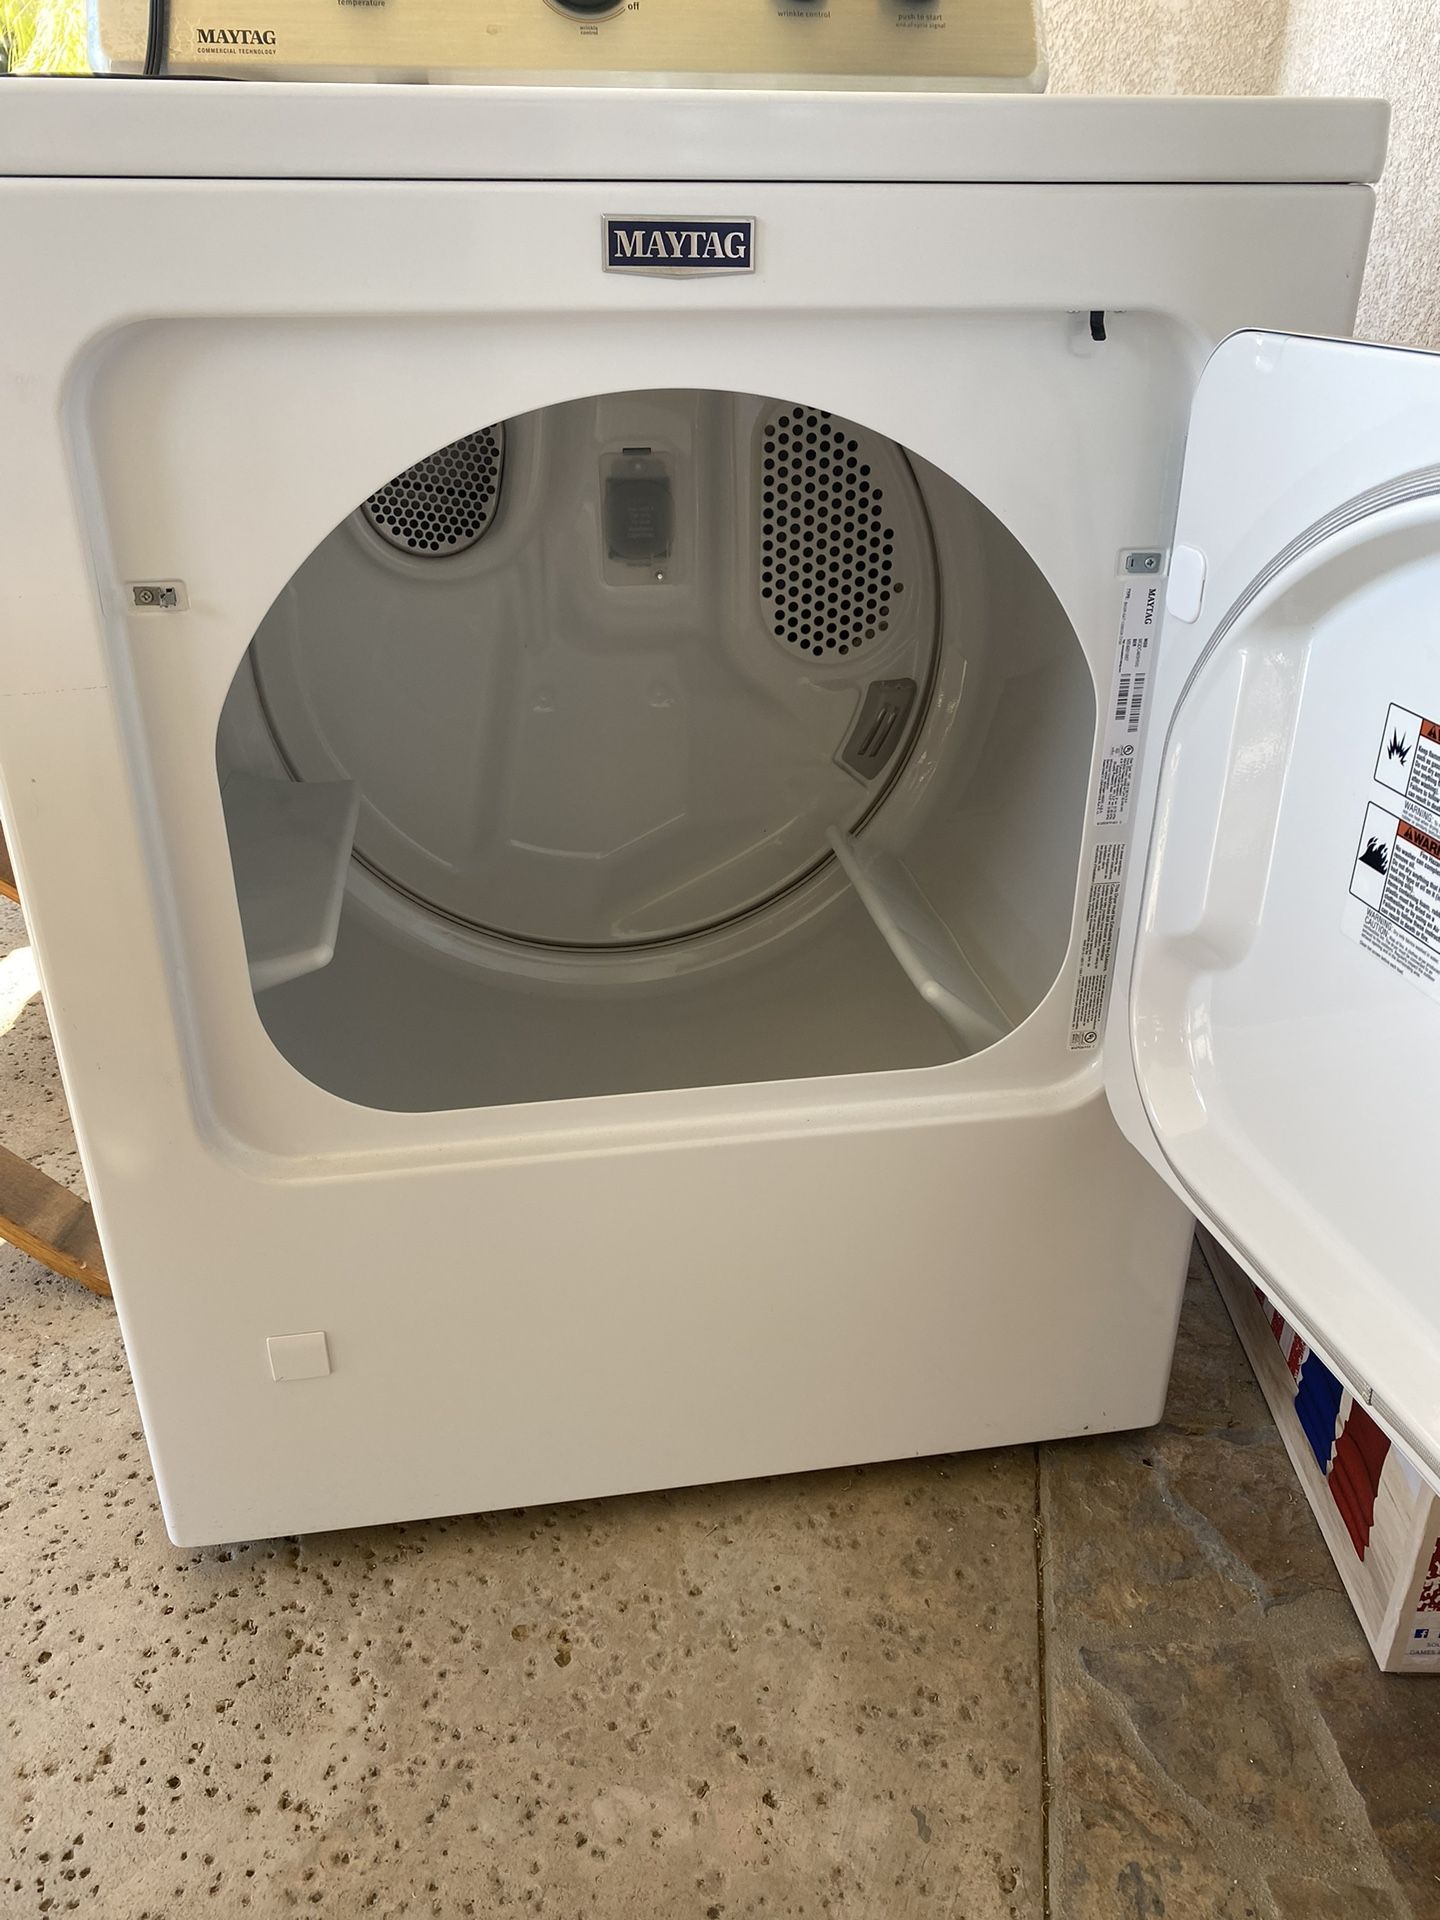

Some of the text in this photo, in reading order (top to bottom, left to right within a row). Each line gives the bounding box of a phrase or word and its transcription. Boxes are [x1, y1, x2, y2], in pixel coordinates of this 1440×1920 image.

[627, 1, 640, 11] off
[196, 28, 276, 45] MAYTAG
[197, 47, 237, 55] COMMERCIAL
[613, 230, 747, 259] MAYTAG
[1145, 589, 1156, 624] MAYTAG
